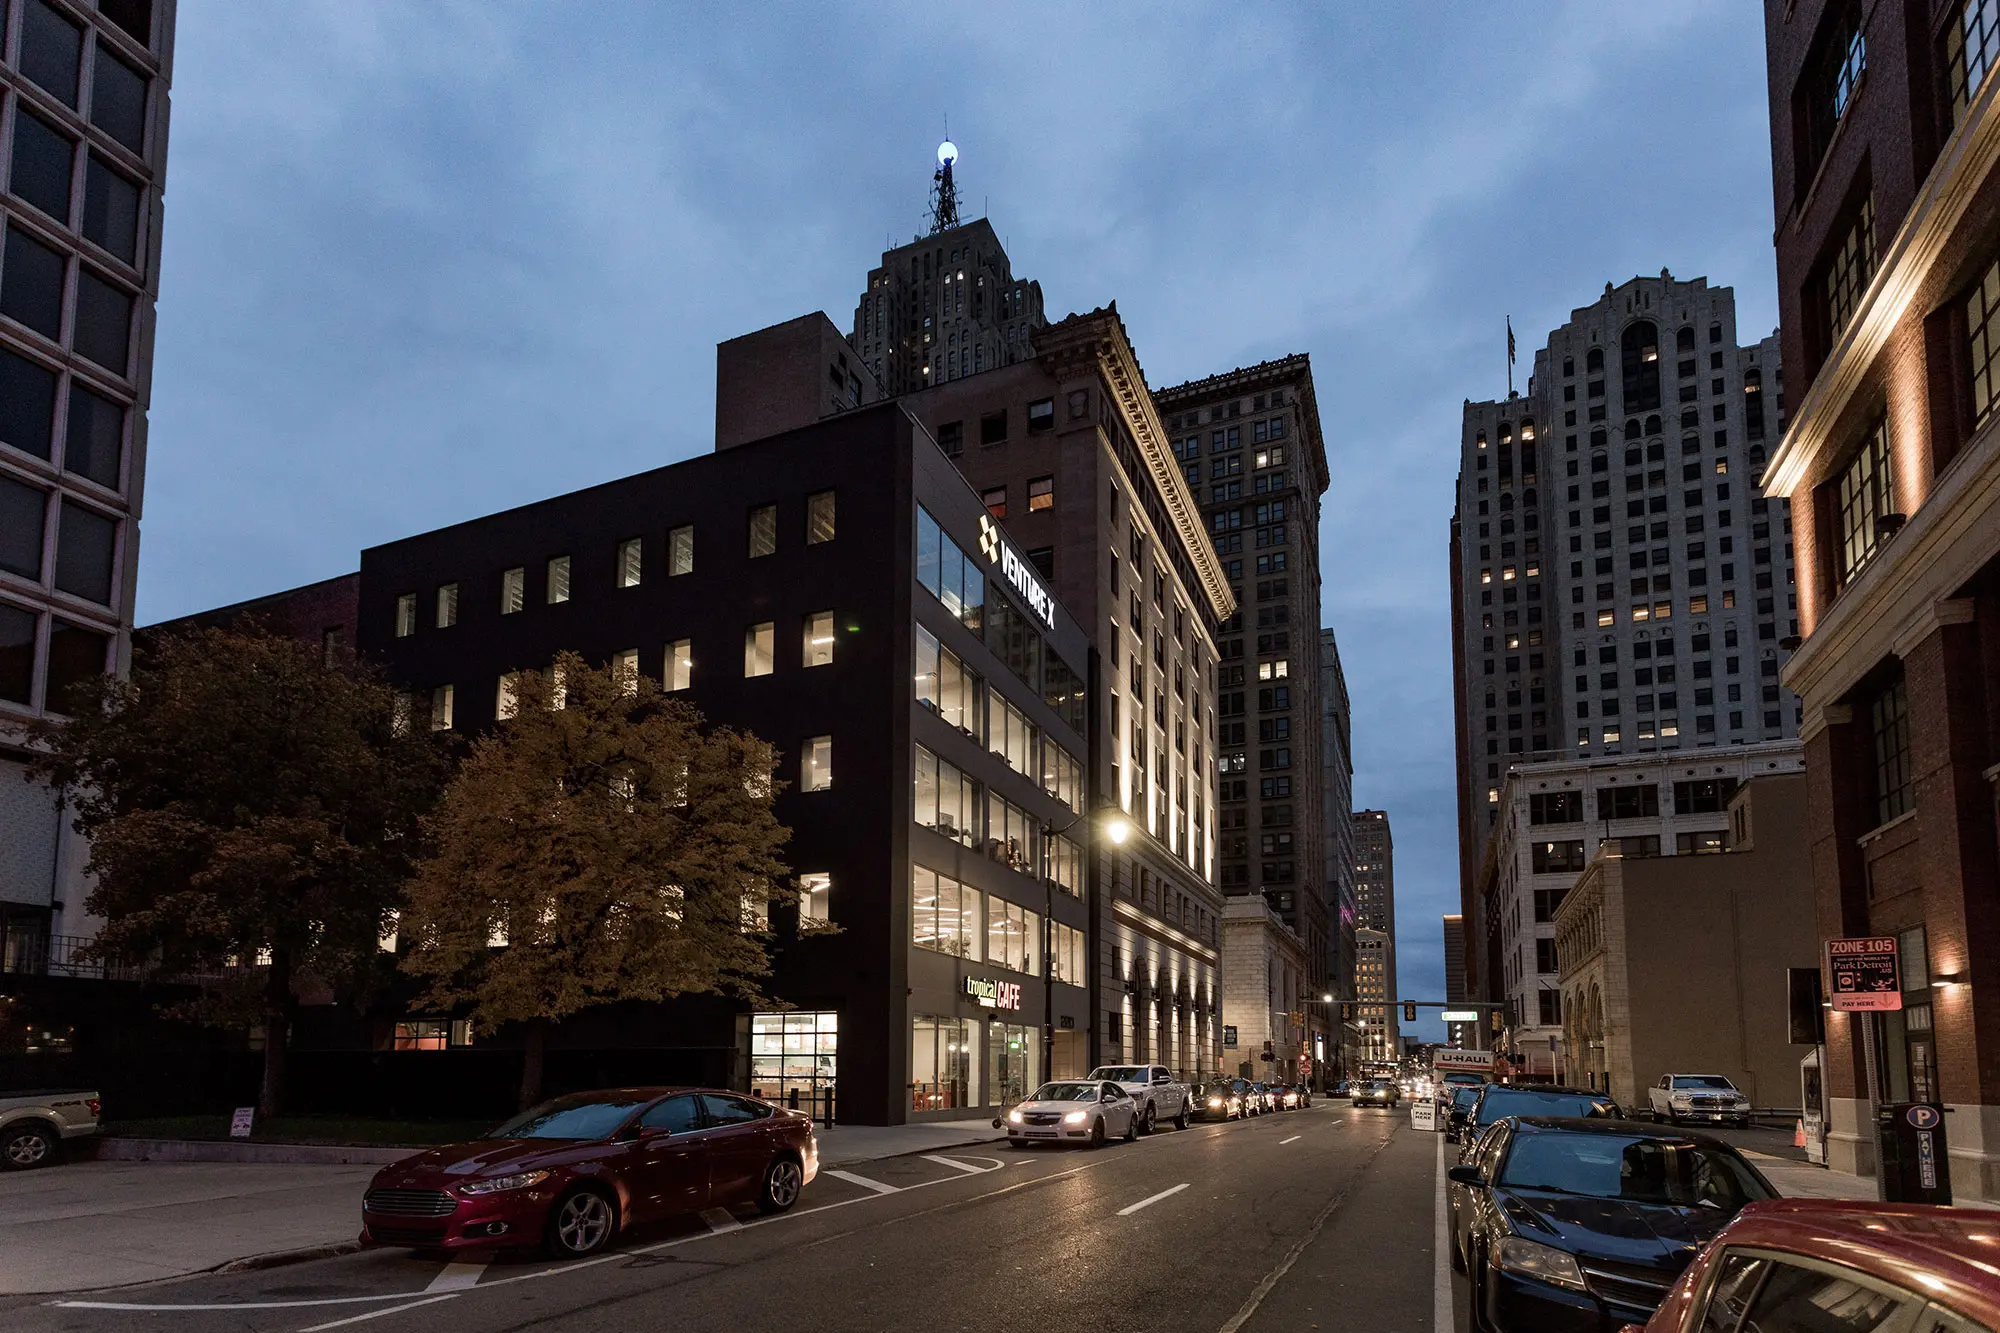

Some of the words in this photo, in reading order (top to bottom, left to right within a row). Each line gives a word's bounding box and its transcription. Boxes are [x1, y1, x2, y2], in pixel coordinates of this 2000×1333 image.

[1001, 540, 1047, 620] VENTURE
[1047, 597, 1055, 630] X
[1831, 941, 1865, 953] ZONE
[1867, 940, 1893, 952] 105
[967, 976, 997, 999] tropical
[997, 981, 1020, 1010] CAFE
[1442, 1054, 1489, 1063] U-HAUL
[1916, 1109, 1931, 1125] P
[1920, 1133, 1930, 1155] PAY
[1922, 1157, 1933, 1186] HERE
